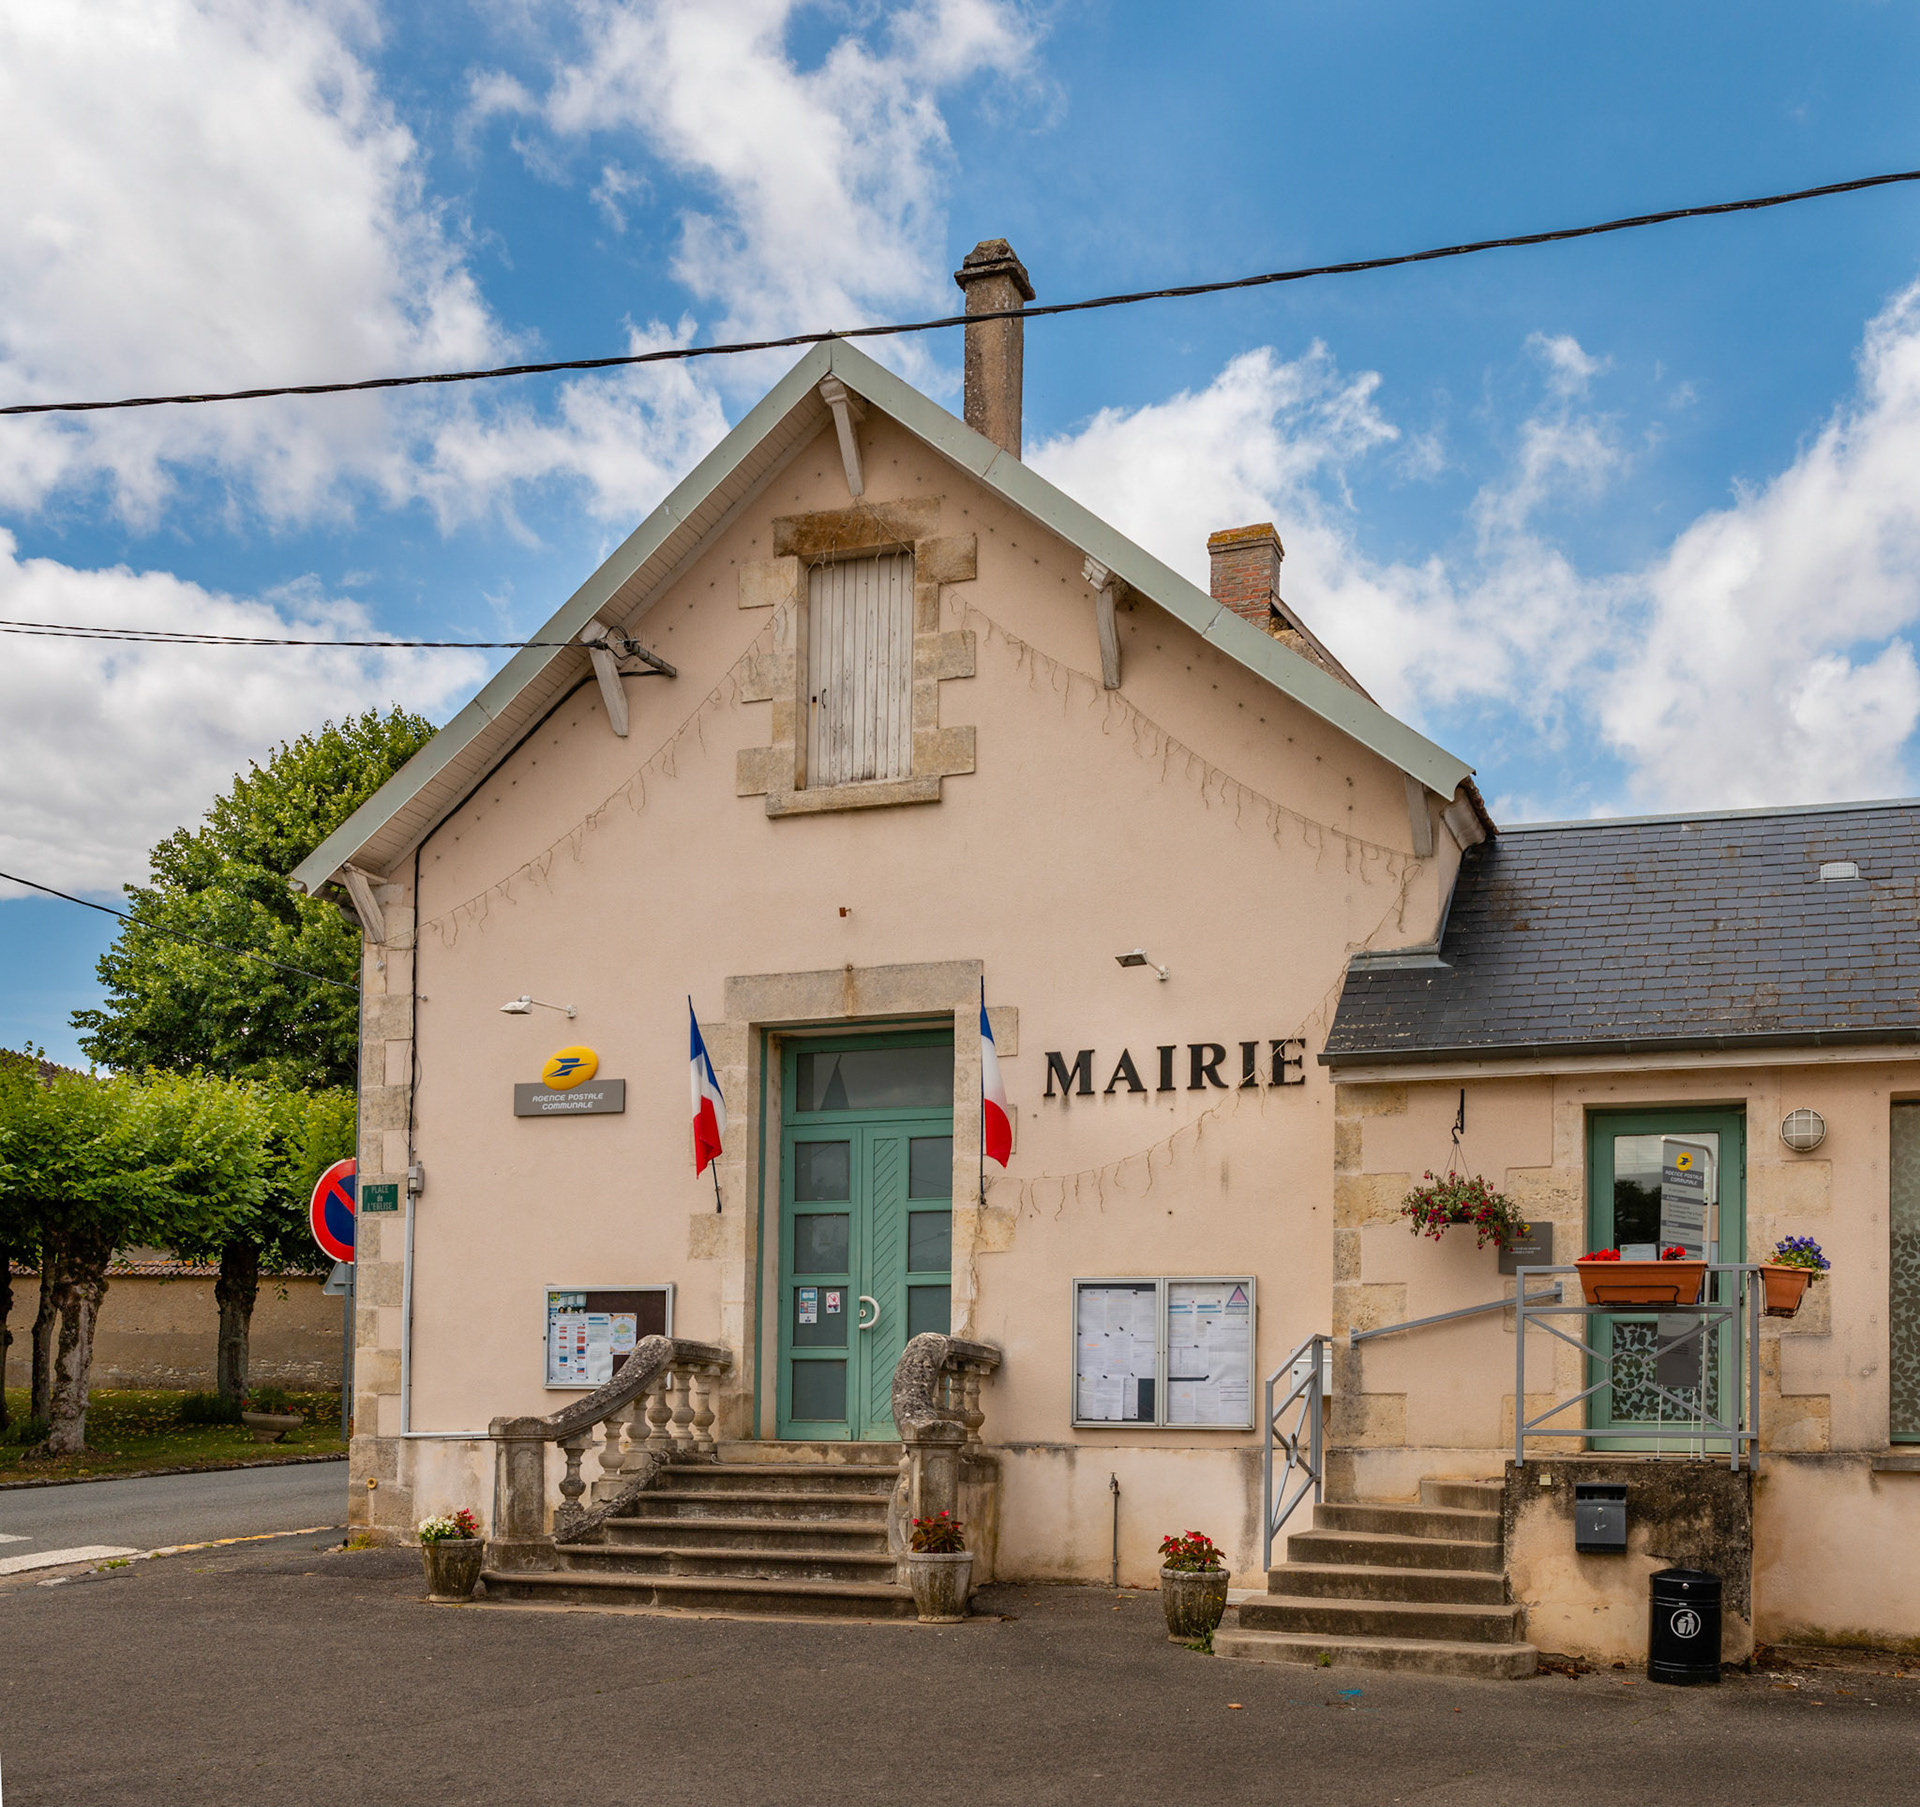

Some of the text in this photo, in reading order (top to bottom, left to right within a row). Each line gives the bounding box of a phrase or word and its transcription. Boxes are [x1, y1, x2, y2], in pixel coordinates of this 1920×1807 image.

[1043, 1038, 1306, 1097] MAIRIE
[532, 1092, 605, 1102] AGENCE POSTALE
[542, 1101, 594, 1110] COMMUNALE
[371, 1185, 389, 1194] PLACE
